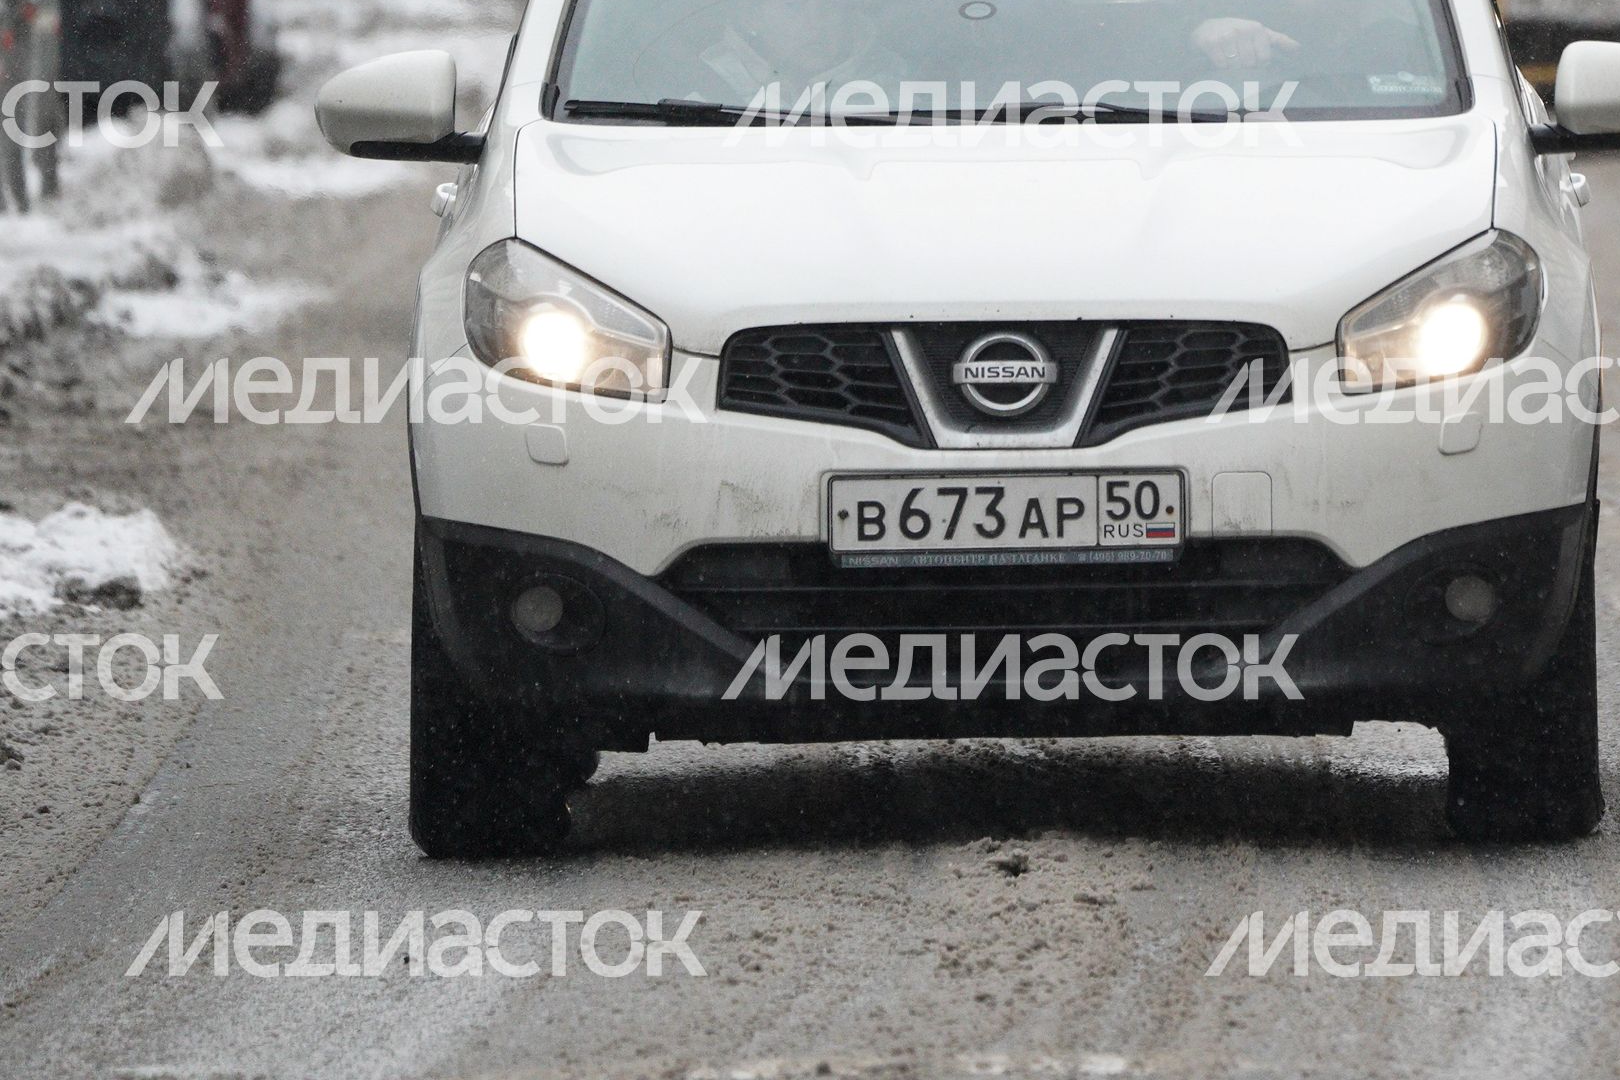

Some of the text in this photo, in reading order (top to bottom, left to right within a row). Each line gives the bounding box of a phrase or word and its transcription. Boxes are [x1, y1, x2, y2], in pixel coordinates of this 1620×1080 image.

[964, 366, 1046, 379] NISSAN
[1106, 480, 1160, 520] 50
[1104, 524, 1144, 538] RUS
[848, 555, 899, 567] NISSAN
